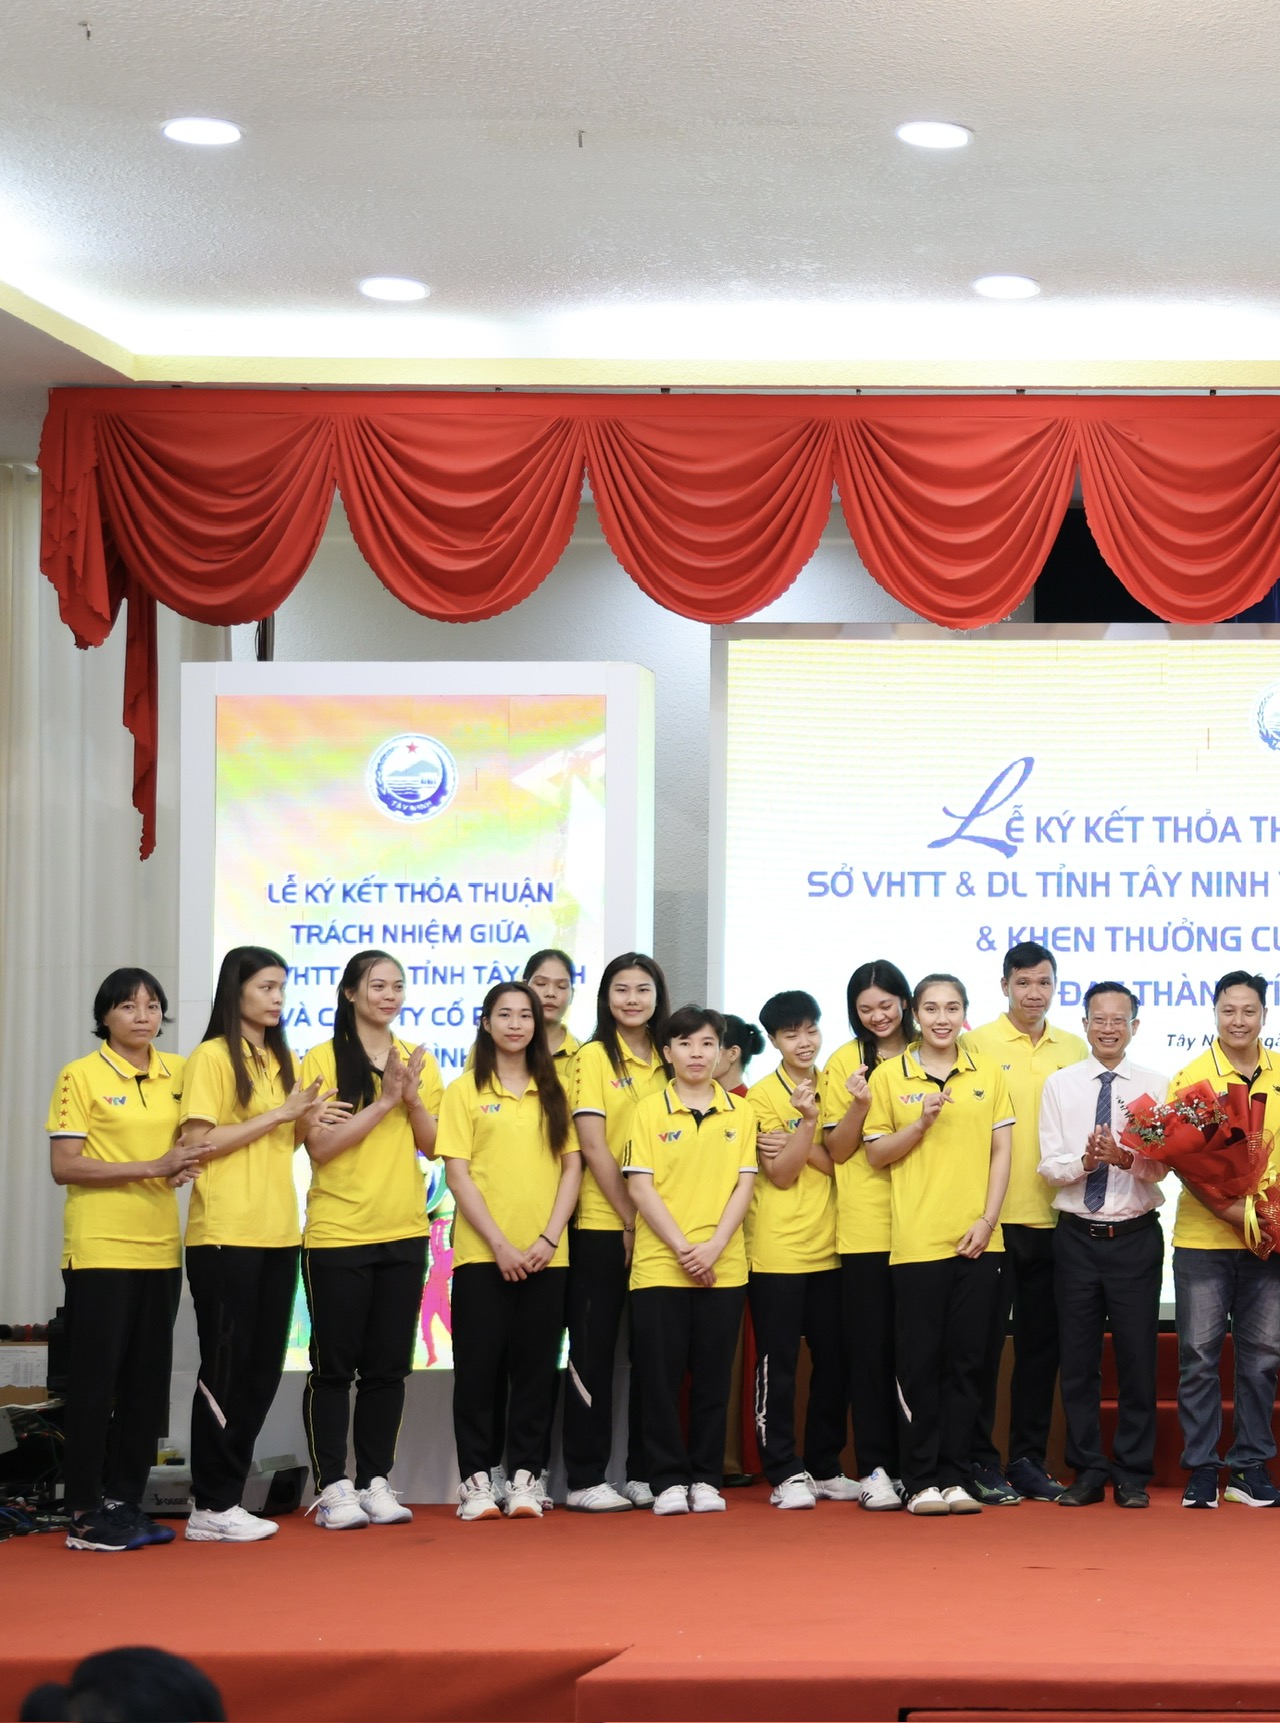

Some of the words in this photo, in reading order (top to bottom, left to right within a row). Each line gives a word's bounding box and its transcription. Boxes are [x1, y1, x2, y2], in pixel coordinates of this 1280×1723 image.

[928, 757, 1035, 858] LỄ
[1036, 811, 1075, 842] KÝ
[1085, 805, 1144, 843] KẾT
[1153, 808, 1241, 843] THỎA
[268, 874, 297, 903] LỄ
[305, 877, 336, 904] KÝ
[342, 875, 388, 903] KẾT
[394, 876, 462, 903] THỎA
[468, 876, 553, 908] THUẬN
[808, 864, 854, 897] SỞ
[863, 871, 946, 897] VHTT
[957, 871, 976, 897] &
[988, 871, 1027, 897] DL
[1036, 862, 1110, 897] TỈNH
[1120, 864, 1182, 897] TÂY
[1192, 871, 1268, 897] NINH
[290, 919, 374, 944] TRÁCH
[382, 919, 462, 949] NHIỆM
[470, 919, 530, 943] GIỮA
[977, 926, 996, 951] &
[1008, 926, 1094, 952] KHEN
[1105, 918, 1241, 952] THƯỞNG
[408, 959, 465, 985] TỈNH
[473, 960, 520, 985] TÂY
[1133, 972, 1219, 1007] THÀN
[432, 997, 465, 1027] CỔ
[1167, 1033, 1196, 1051] Tây
[610, 1077, 633, 1089] VTV
[102, 1096, 126, 1105] VTV
[480, 1104, 501, 1114] VTV
[900, 1093, 924, 1104] VTV
[658, 1130, 682, 1143] VTV
